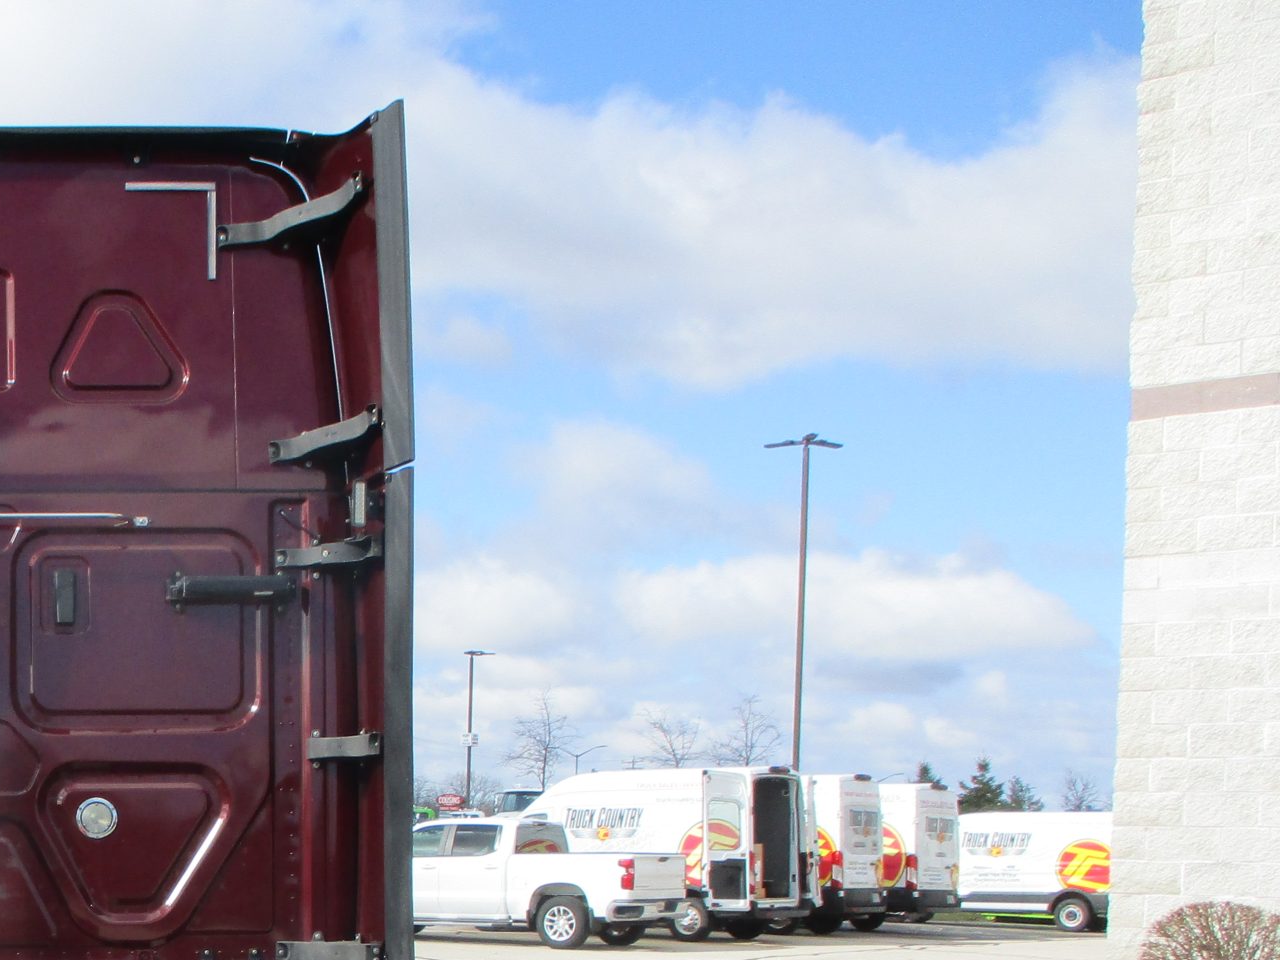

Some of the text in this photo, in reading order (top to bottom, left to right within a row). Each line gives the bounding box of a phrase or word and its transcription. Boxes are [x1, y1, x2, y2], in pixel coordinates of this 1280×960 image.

[565, 807, 644, 829] TRUCK COUNTRY
[961, 831, 1032, 848] TRUCK COUNTRY
